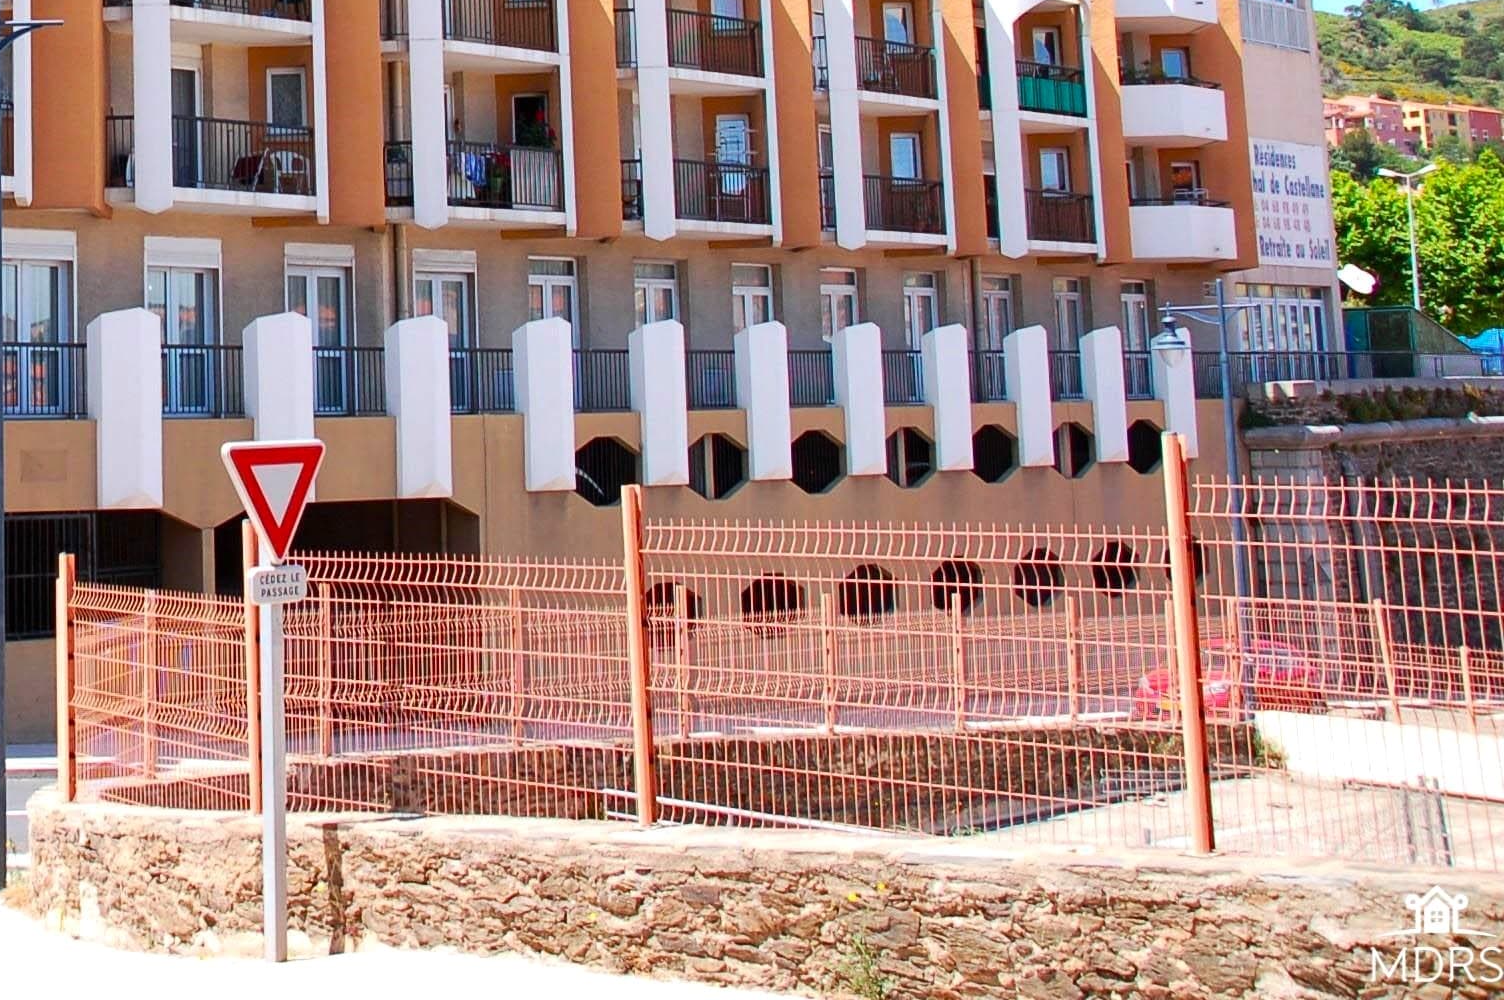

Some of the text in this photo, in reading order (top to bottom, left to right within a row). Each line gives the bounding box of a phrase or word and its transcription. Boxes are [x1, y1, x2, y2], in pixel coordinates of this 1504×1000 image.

[1270, 172, 1280, 194] de
[1284, 175, 1324, 198] Castellane
[1259, 235, 1330, 260] Retraite au Soleil
[260, 572, 300, 585] CÉDEZ LE
[261, 585, 299, 597] PASSAGE
